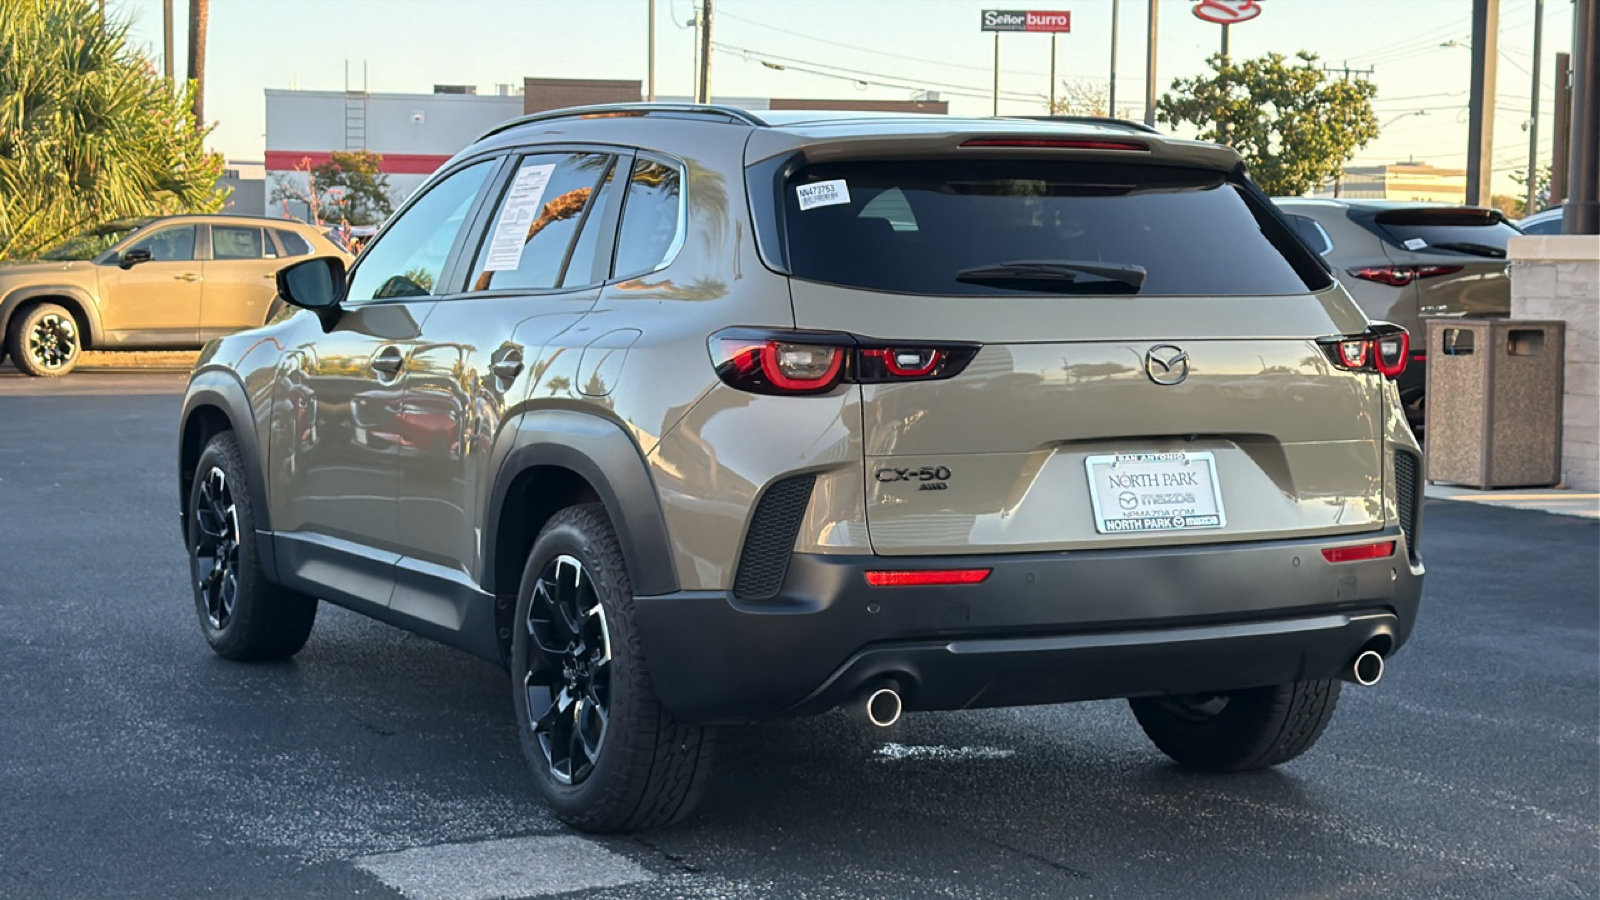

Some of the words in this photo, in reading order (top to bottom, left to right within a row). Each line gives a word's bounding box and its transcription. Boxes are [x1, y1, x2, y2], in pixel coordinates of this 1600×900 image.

[984, 10, 1025, 26] Señor
[1026, 12, 1067, 26] burro
[1141, 453, 1185, 461] ANTONIO
[875, 465, 951, 482] CX-50
[1108, 473, 1159, 489] NORTH
[1162, 471, 1199, 487] PARK
[918, 482, 949, 491] AWD
[1140, 492, 1196, 506] mazda
[1106, 519, 1144, 531] NORTH
[1144, 518, 1172, 530] PARK
